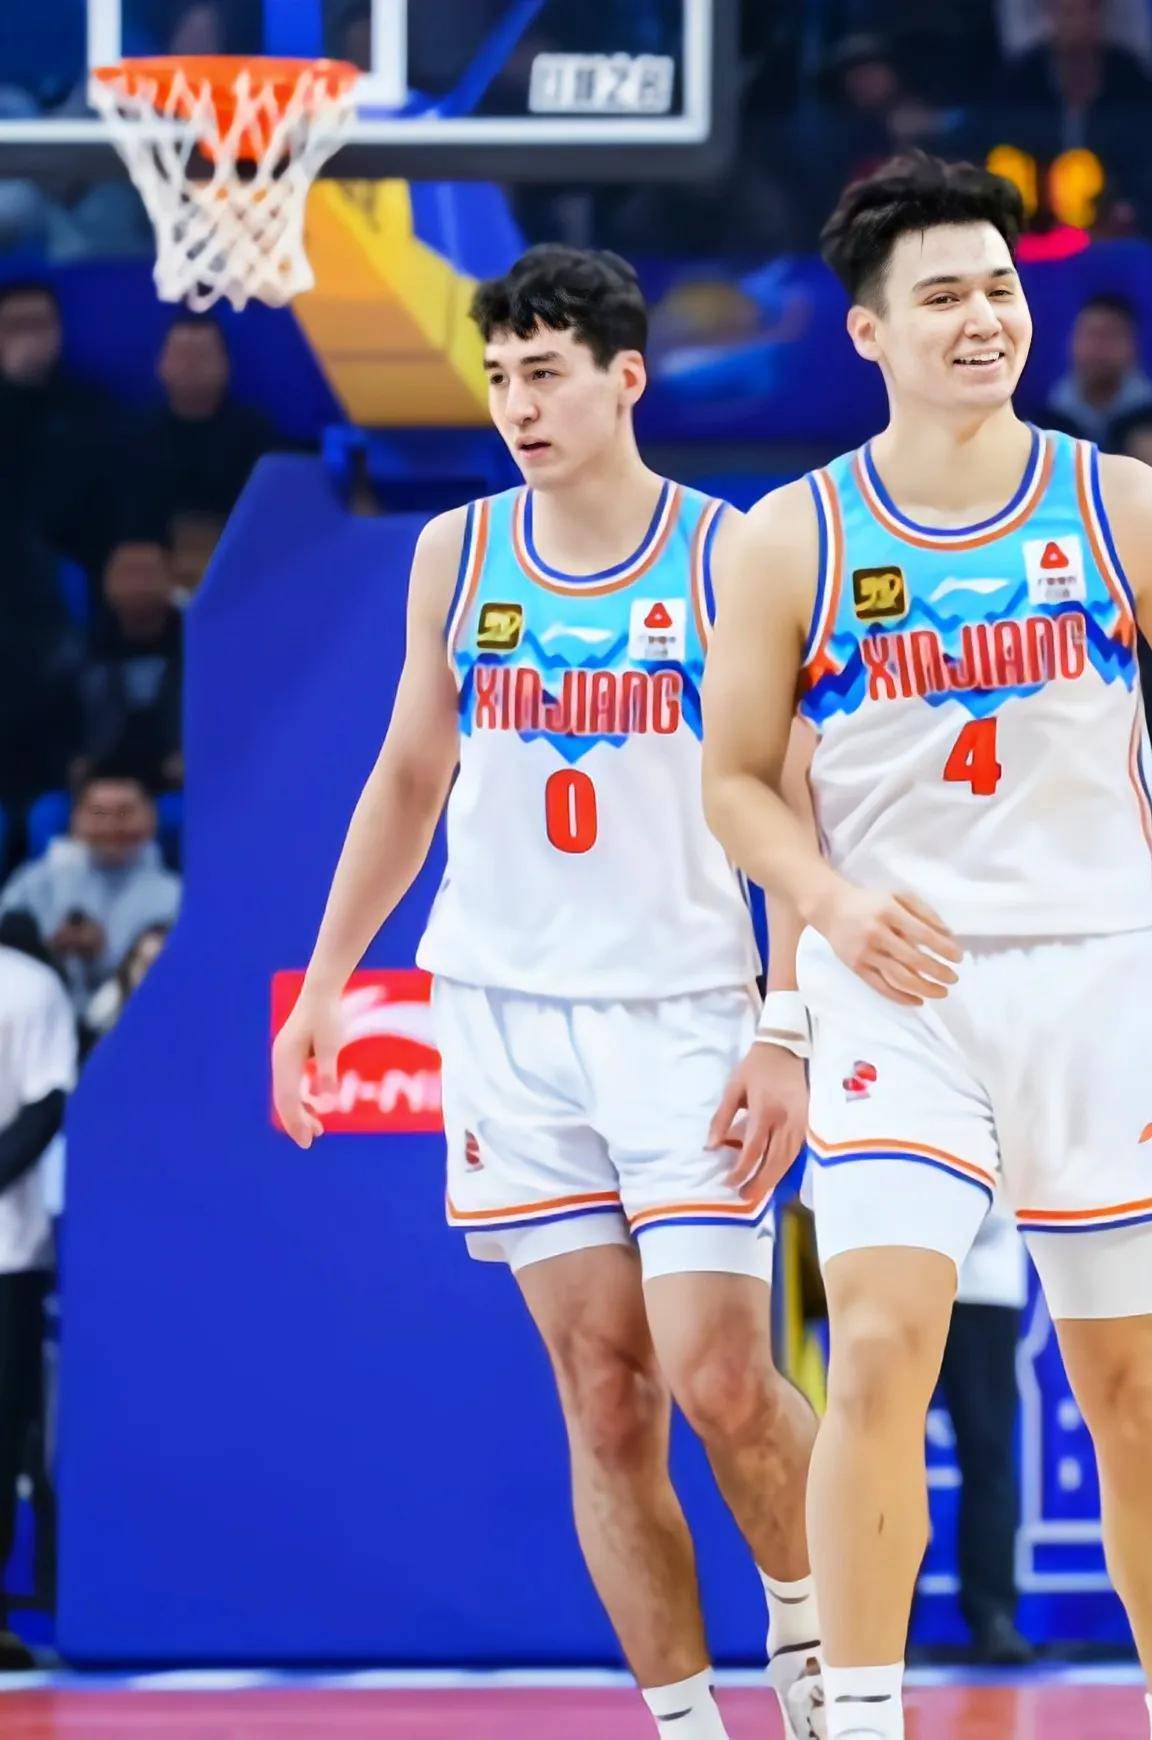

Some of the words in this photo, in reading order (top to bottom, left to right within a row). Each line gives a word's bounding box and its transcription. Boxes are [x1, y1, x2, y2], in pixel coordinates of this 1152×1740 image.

[860, 612, 1087, 702] XINJIANG
[474, 666, 684, 736] XINJIANG
[942, 716, 1002, 796] 4
[544, 768, 598, 854] 0
